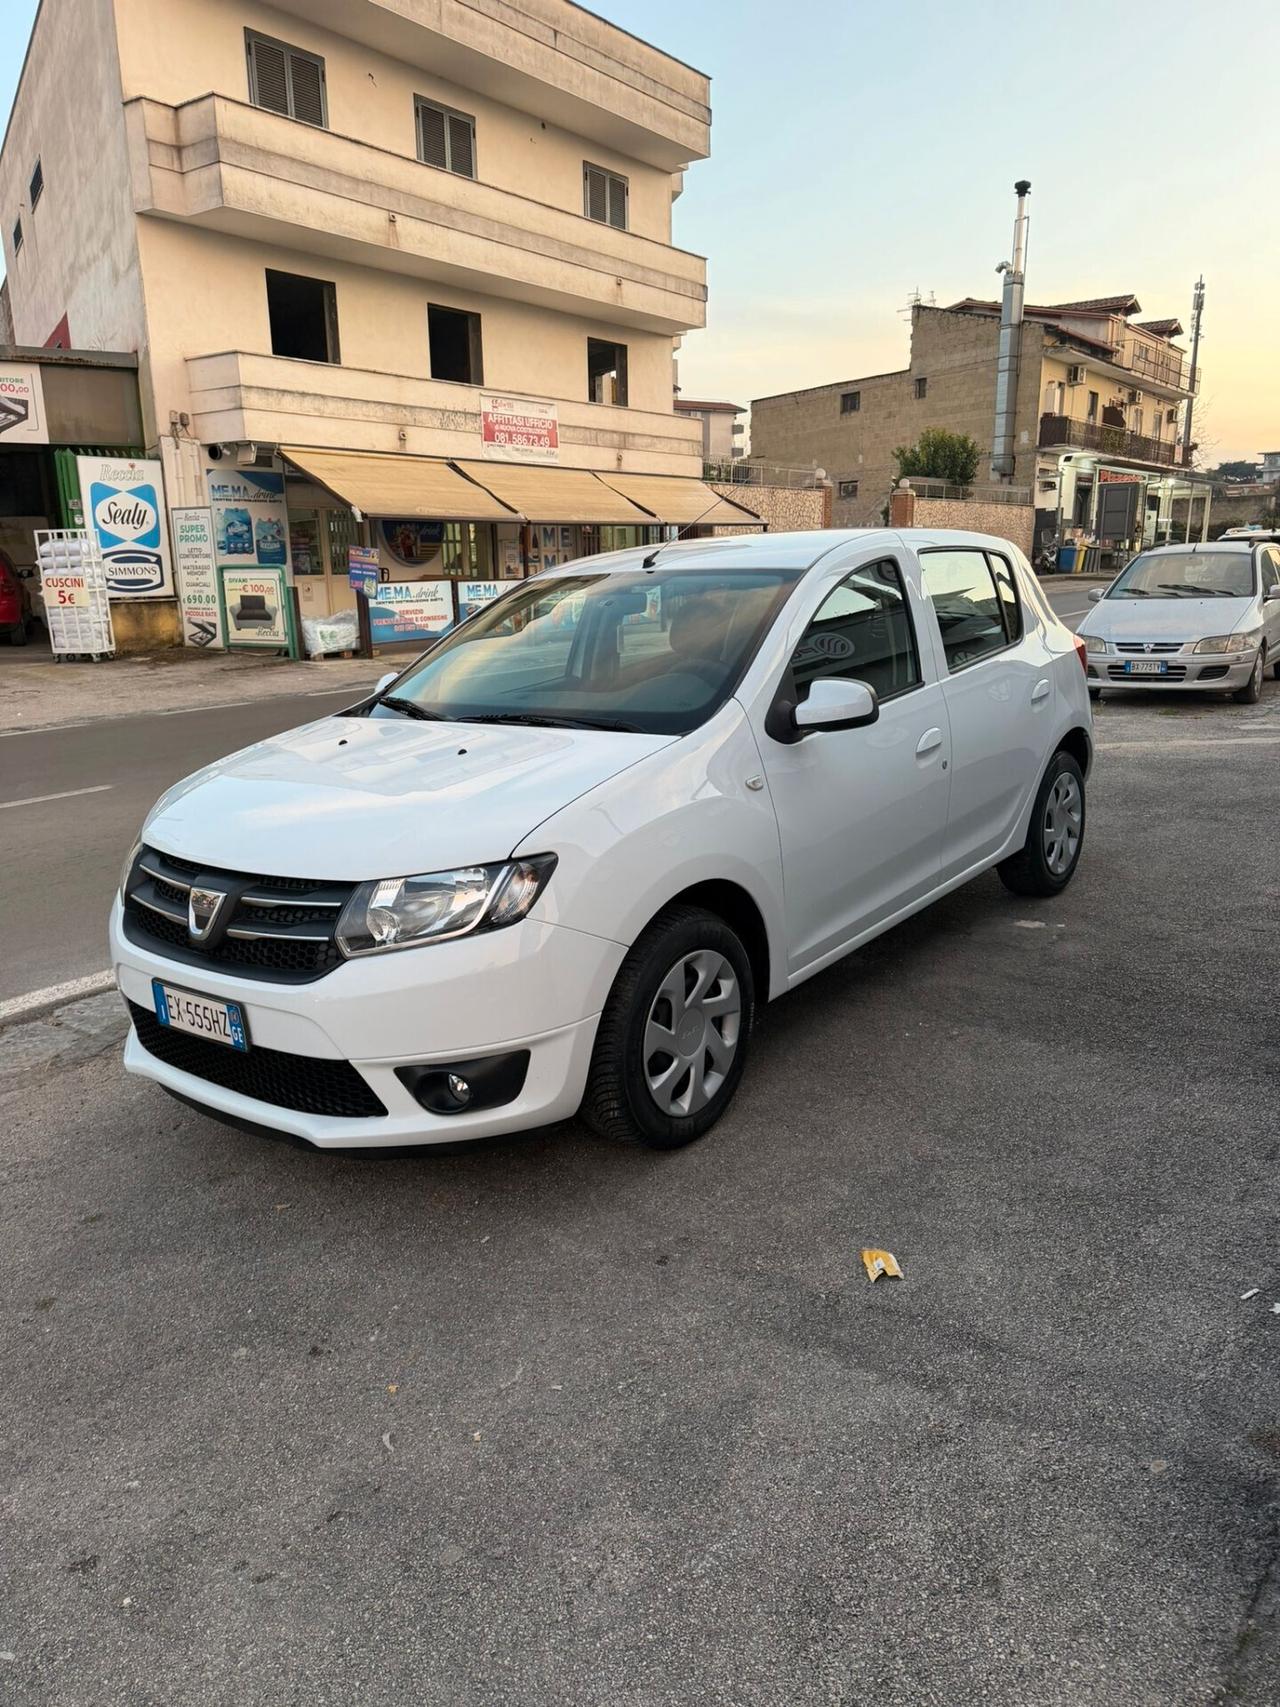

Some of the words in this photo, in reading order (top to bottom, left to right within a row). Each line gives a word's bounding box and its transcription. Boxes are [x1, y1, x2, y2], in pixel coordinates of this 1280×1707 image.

[488, 412, 525, 426] AFFITTASI
[524, 416, 554, 430] UFFICIO
[100, 463, 145, 482] Reccia
[102, 501, 148, 530] Sealy
[180, 524, 206, 534] SUPER
[179, 533, 209, 543] PROMO
[108, 566, 158, 577] SIMMONS
[45, 577, 85, 588] CUSCINI
[231, 1025, 244, 1044] GE
